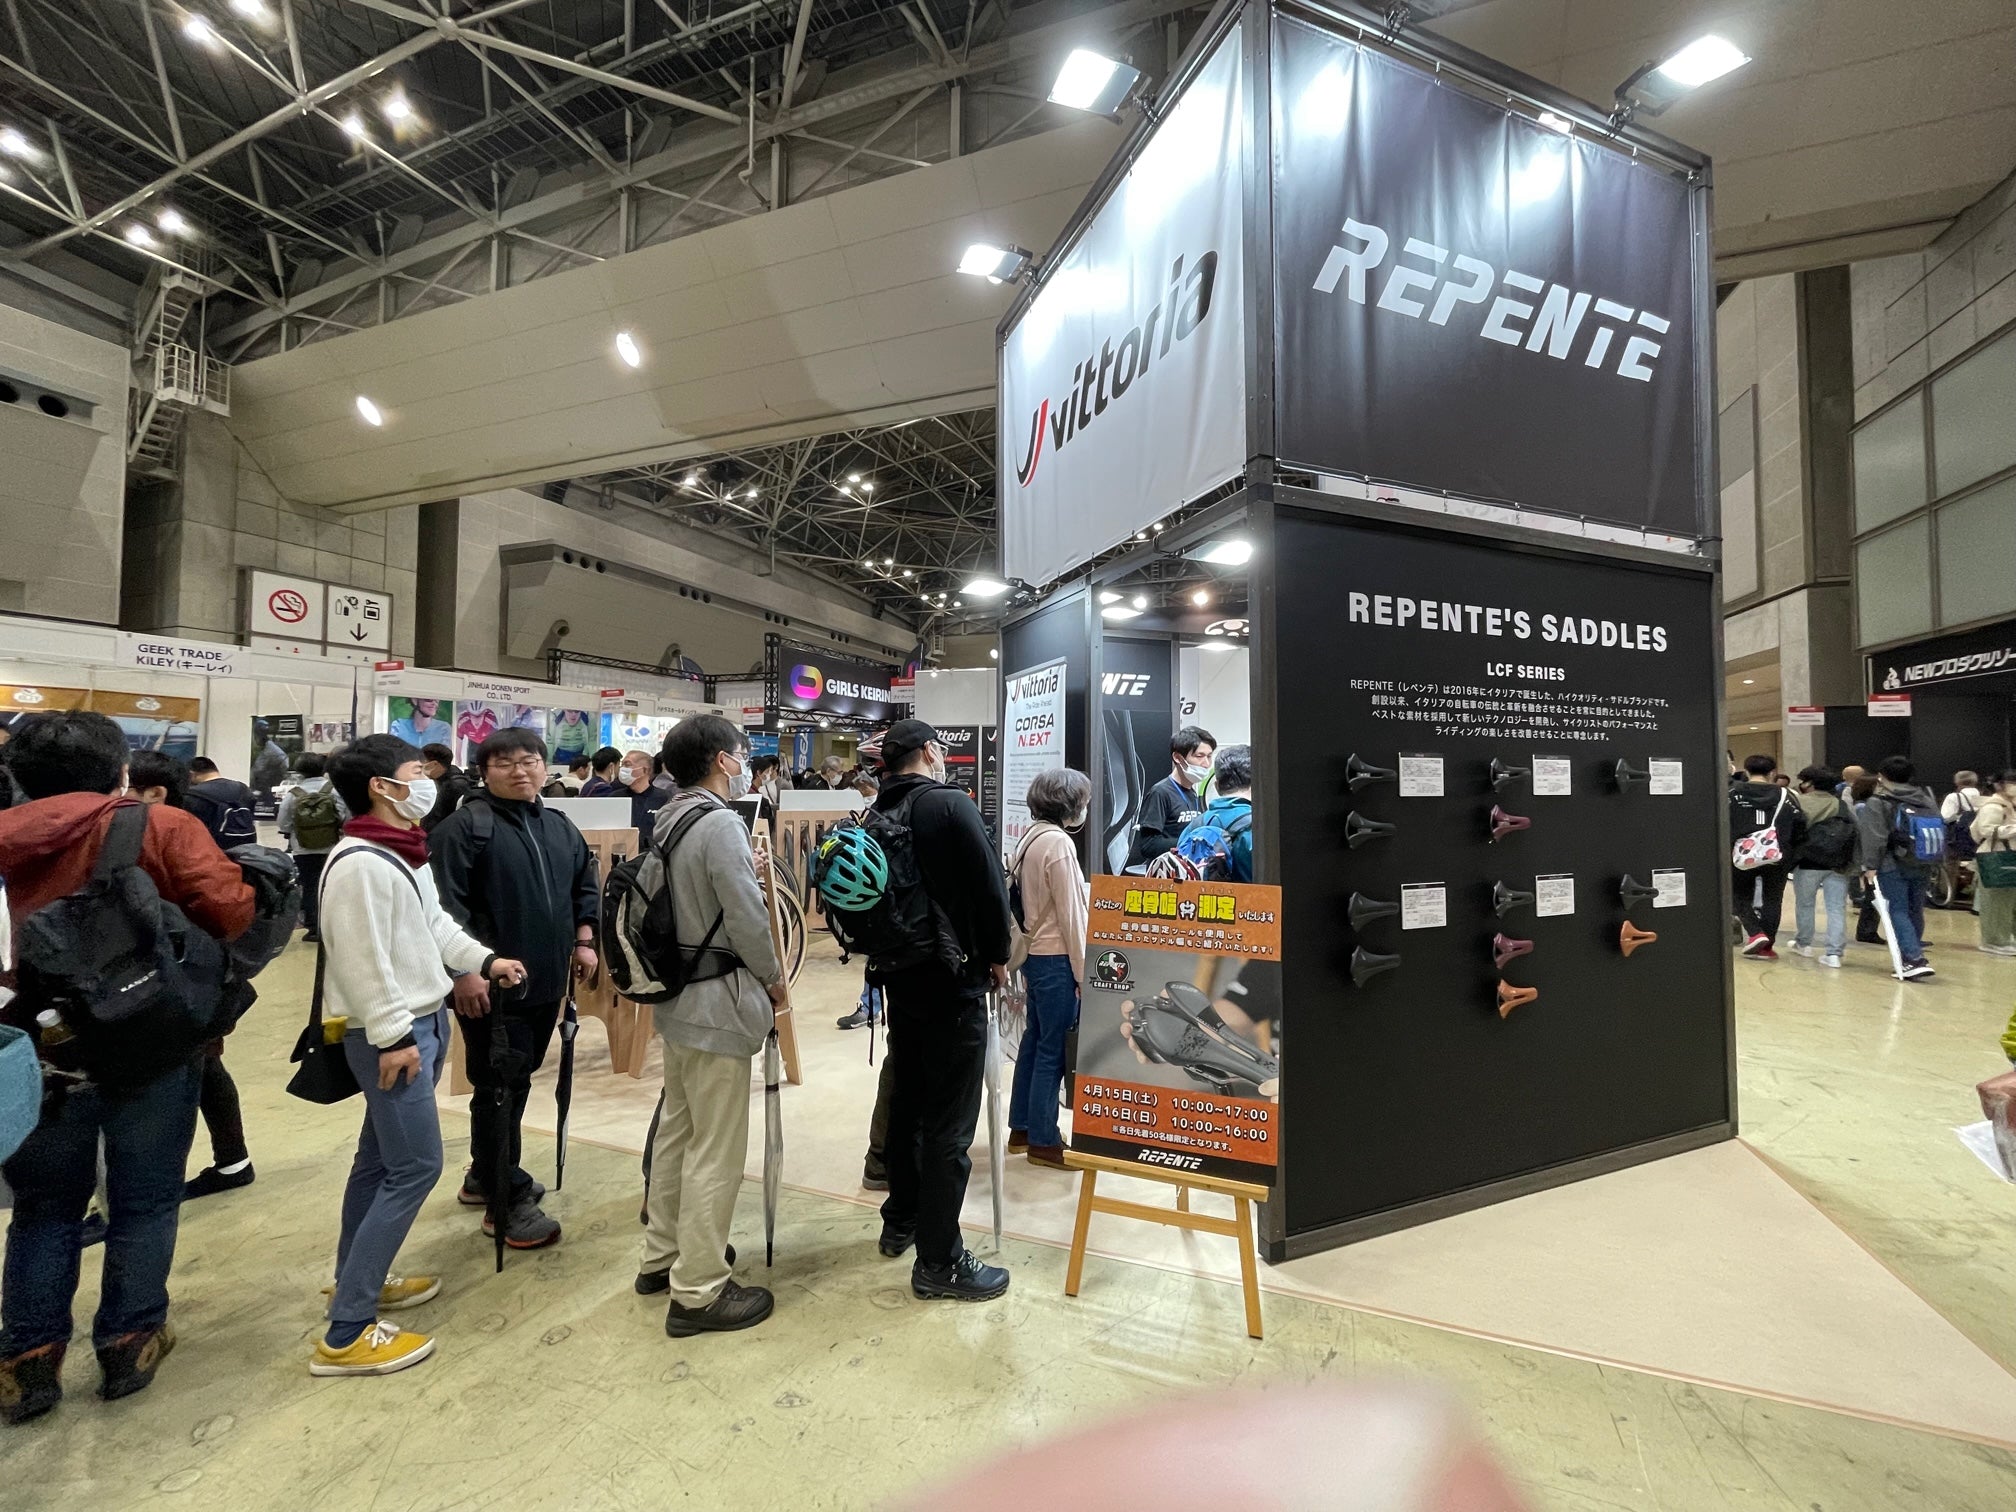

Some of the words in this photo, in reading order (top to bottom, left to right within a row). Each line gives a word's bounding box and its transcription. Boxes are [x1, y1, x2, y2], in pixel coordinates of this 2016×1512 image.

[1312, 217, 1670, 382] REPENTE
[1051, 251, 1218, 452] vittoria
[1348, 591, 1531, 640] REPENTE'S
[1541, 614, 1668, 653] SADDLES
[138, 644, 173, 656] GEEK
[1487, 662, 1513, 677] LCF
[1517, 664, 1565, 681] SERIES
[513, 686, 530, 695] SPORT
[826, 678, 859, 699] GIRLS
[861, 684, 891, 703] KEIRIN
[1022, 669, 1058, 699] vittoria
[1102, 672, 1150, 696] NTE
[1016, 713, 1054, 732] CORSA
[936, 729, 971, 742] ttoria
[1177, 810, 1202, 823] REP
[1198, 894, 1236, 922] 測定
[1083, 1084, 1159, 1107] 4月15日(土)
[1082, 1103, 1158, 1126] 4月16日(日)
[1138, 1149, 1203, 1170] REPENTE
